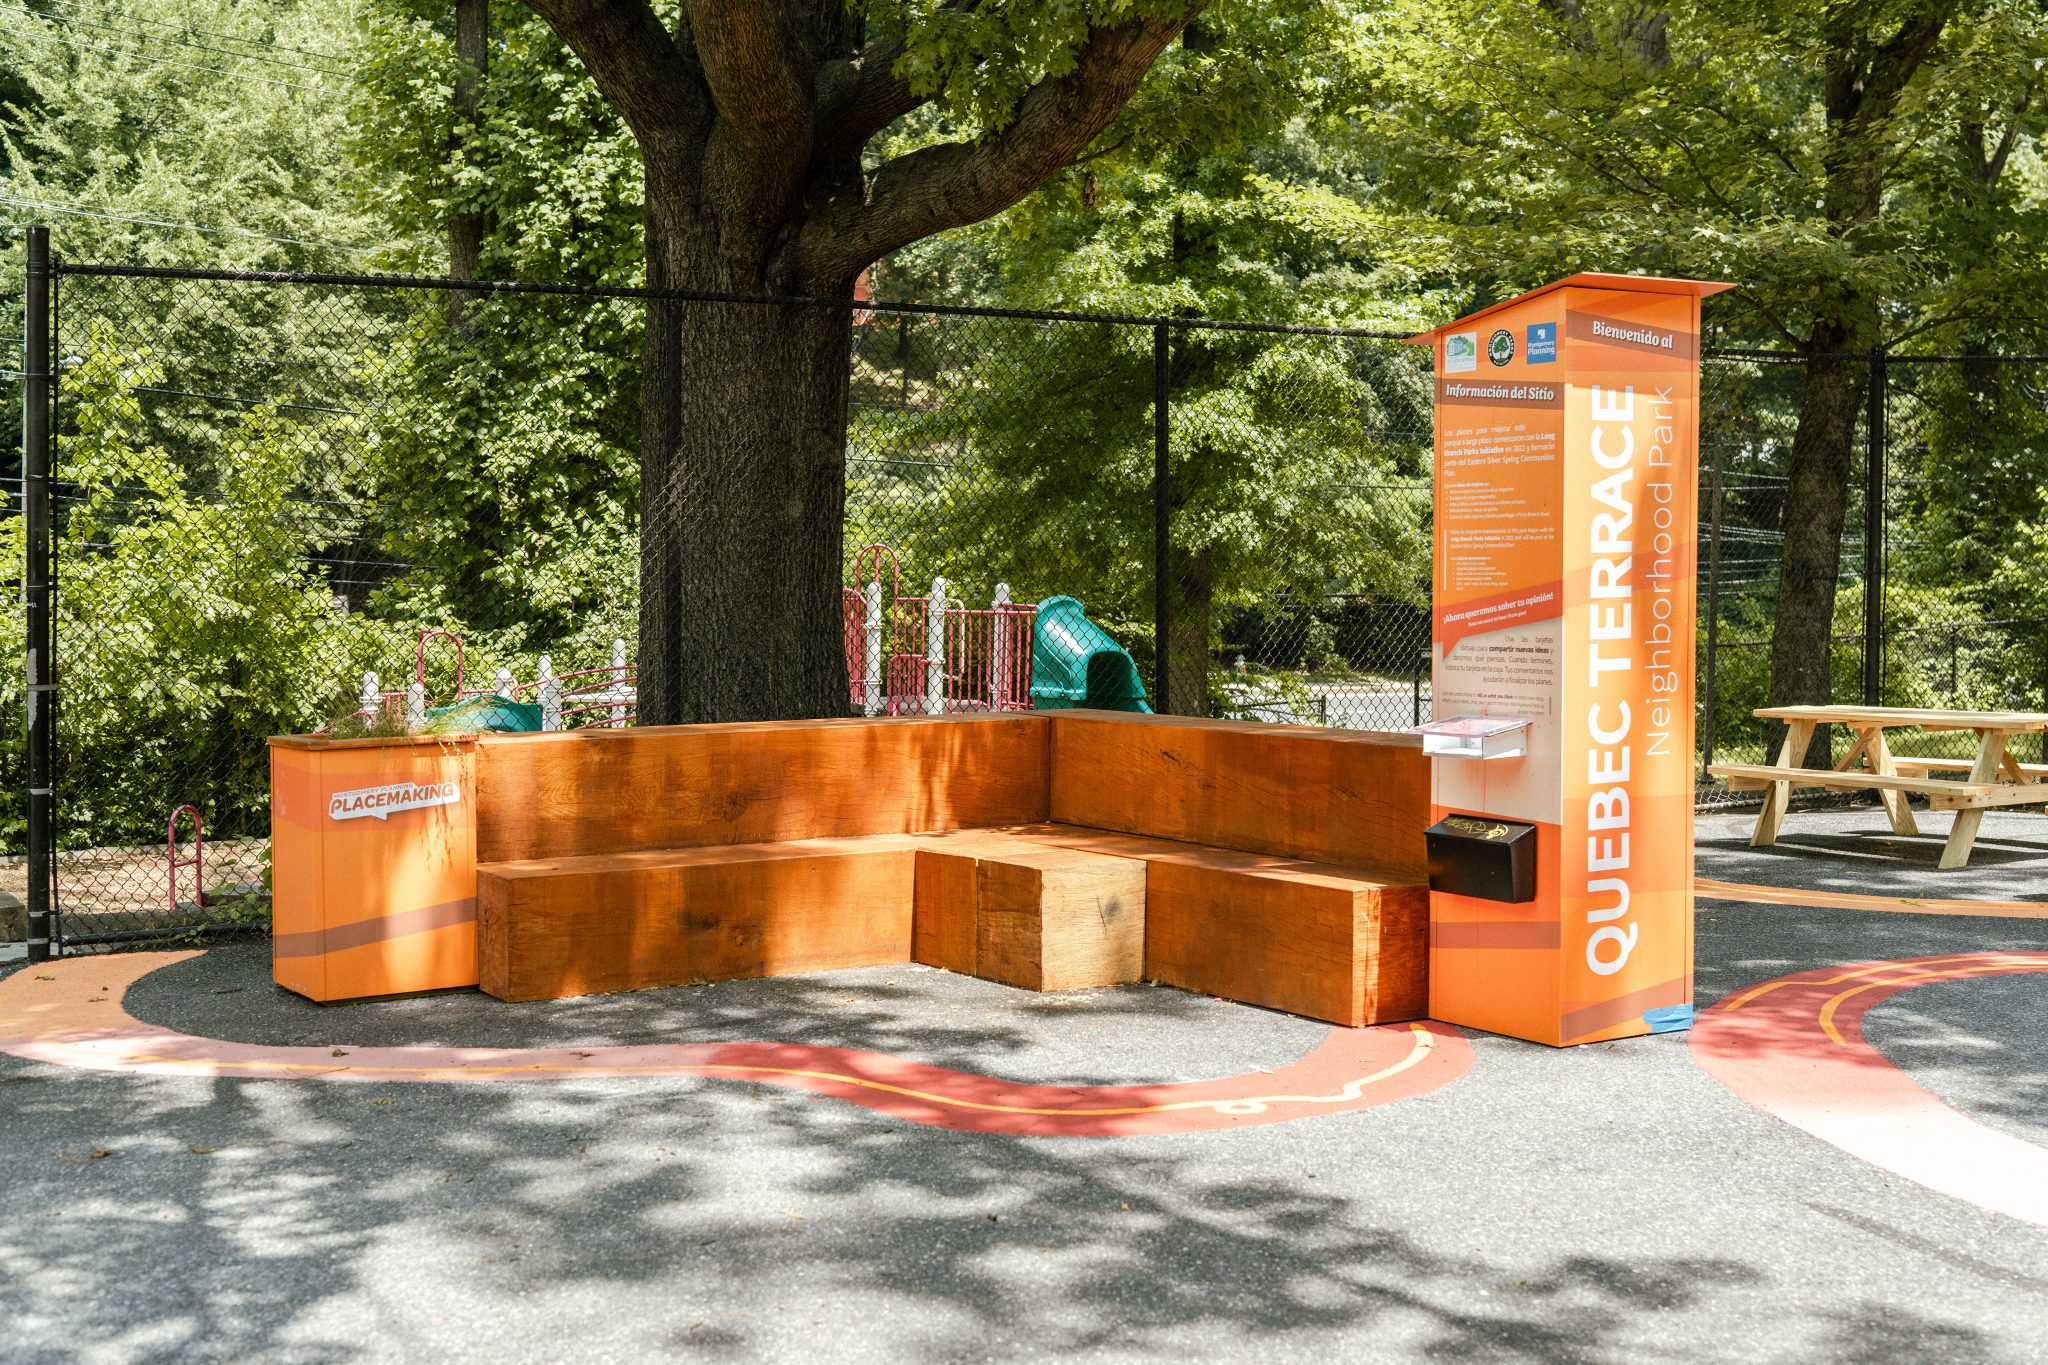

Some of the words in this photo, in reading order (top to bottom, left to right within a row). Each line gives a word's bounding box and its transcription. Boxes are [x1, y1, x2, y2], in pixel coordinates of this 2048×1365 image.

[1593, 321, 1660, 346] Bienvenido
[1661, 334, 1673, 348] al
[1527, 346, 1555, 356] Planning
[1446, 384, 1509, 399] Información
[1511, 386, 1527, 400] del
[1529, 386, 1554, 401] Sitio
[1647, 386, 1673, 466] Park
[1589, 384, 1634, 687] TERRACE
[1443, 614, 1464, 624] ¡Ahora
[1465, 606, 1497, 619] queremos
[1498, 601, 1517, 612] saber
[1526, 592, 1554, 605] opinión!
[1645, 482, 1678, 756] Neighborhood
[331, 783, 454, 814] PLACEMAKING
[334, 789, 378, 798] MONTGOMERY
[380, 783, 414, 792] PLANNING
[1586, 700, 1638, 976] QUEBEC
